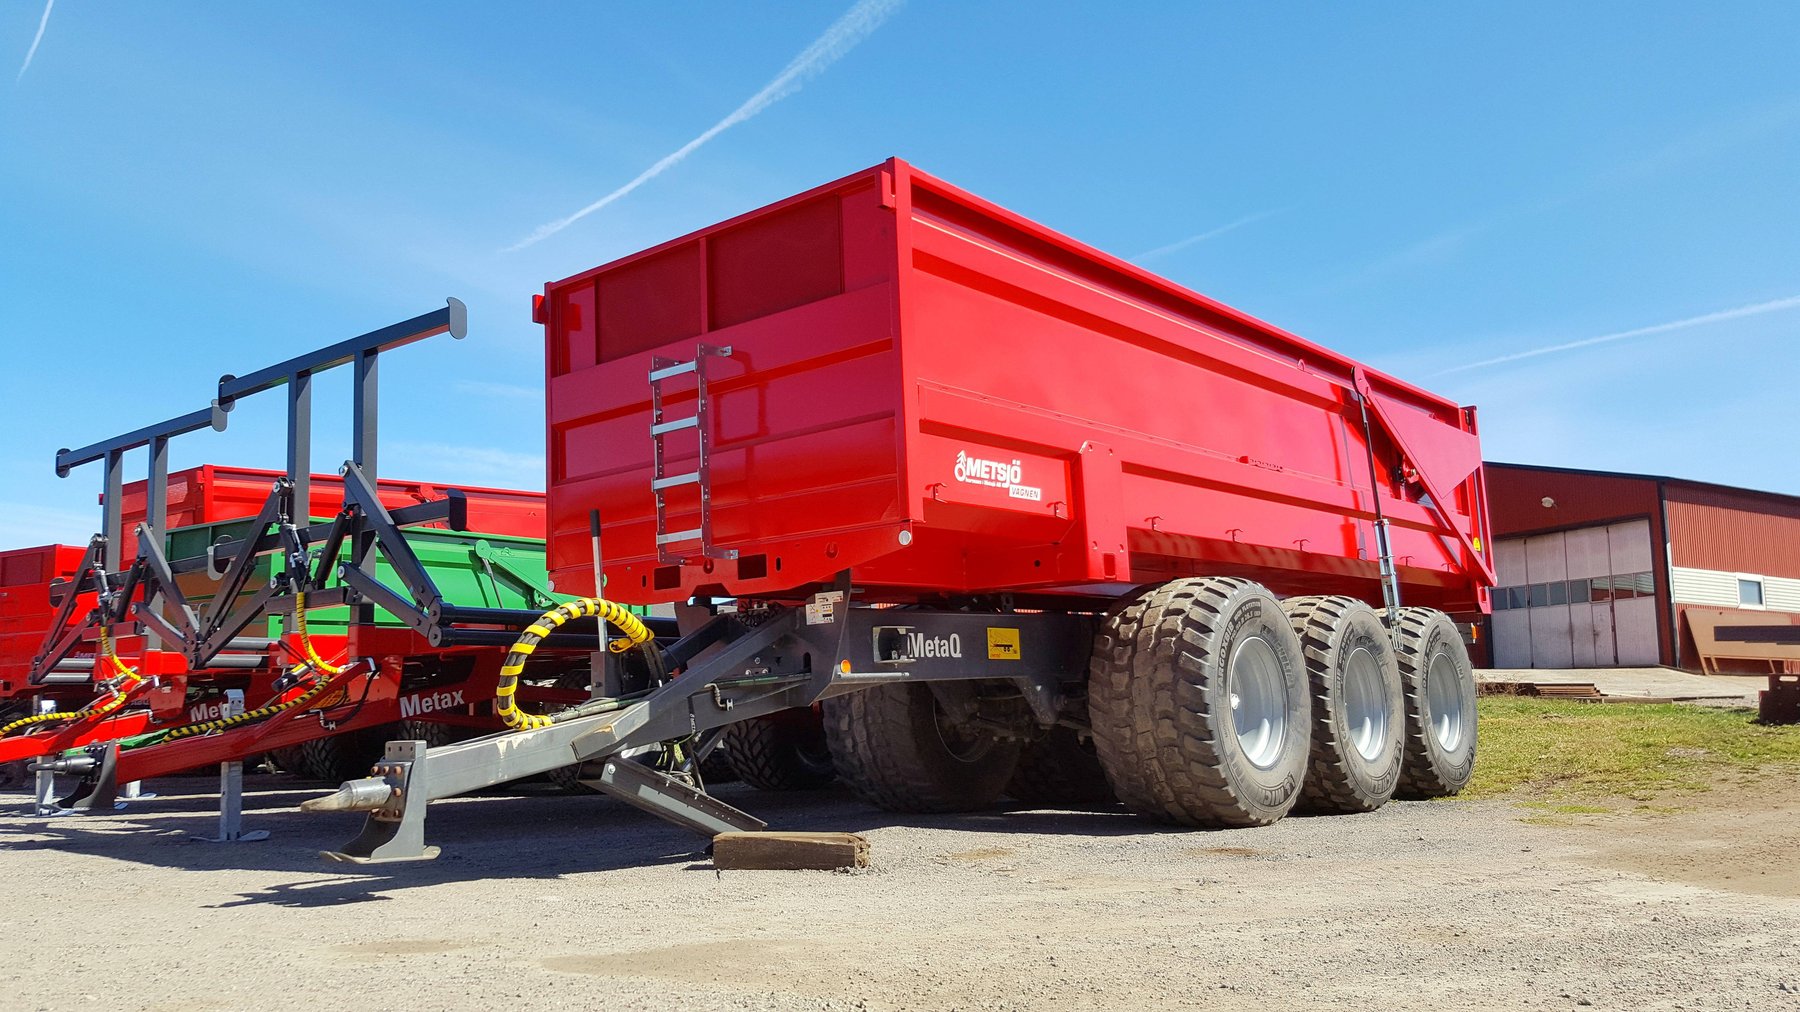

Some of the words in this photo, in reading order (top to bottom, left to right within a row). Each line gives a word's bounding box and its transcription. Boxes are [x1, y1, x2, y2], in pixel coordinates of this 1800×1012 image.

[1011, 486, 1039, 499] VAGNEN
[909, 632, 962, 658] MetaQ
[1218, 621, 1235, 695] CARGOXBIB
[400, 690, 465, 718] Metax
